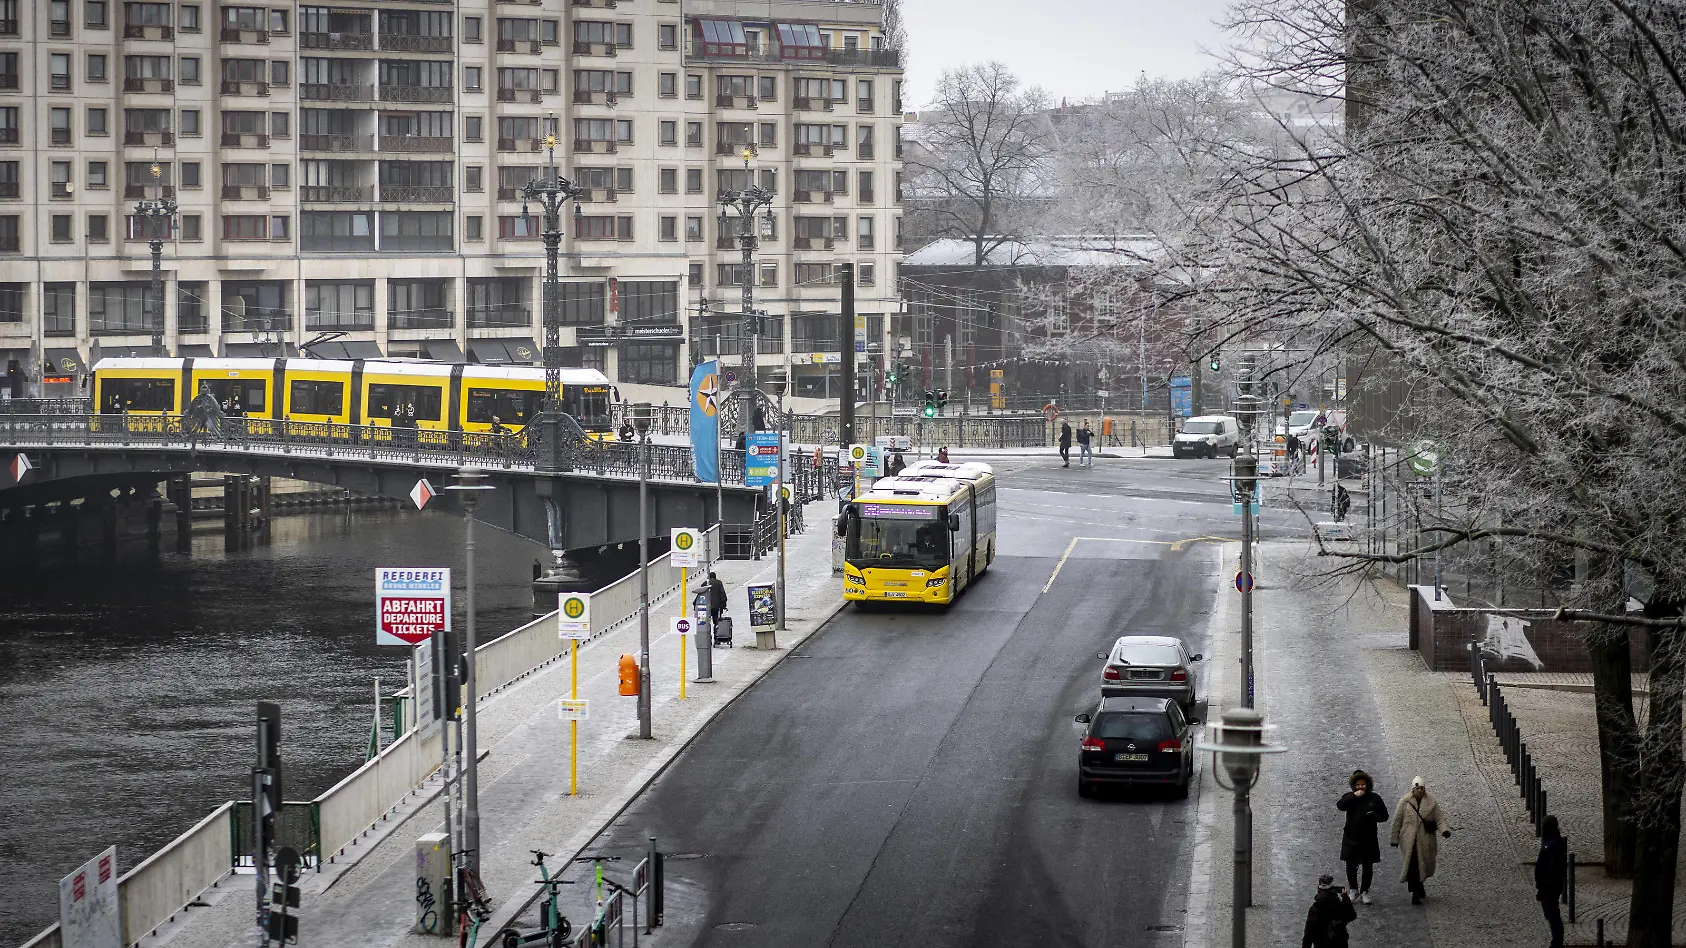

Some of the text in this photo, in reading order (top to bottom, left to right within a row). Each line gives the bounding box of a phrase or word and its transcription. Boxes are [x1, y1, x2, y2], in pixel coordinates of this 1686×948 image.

[383, 571, 443, 580] REEDEREI
[383, 600, 443, 613] ABFAHRT
[384, 613, 443, 623] DEPARTURE
[391, 624, 435, 634] TICKETS
